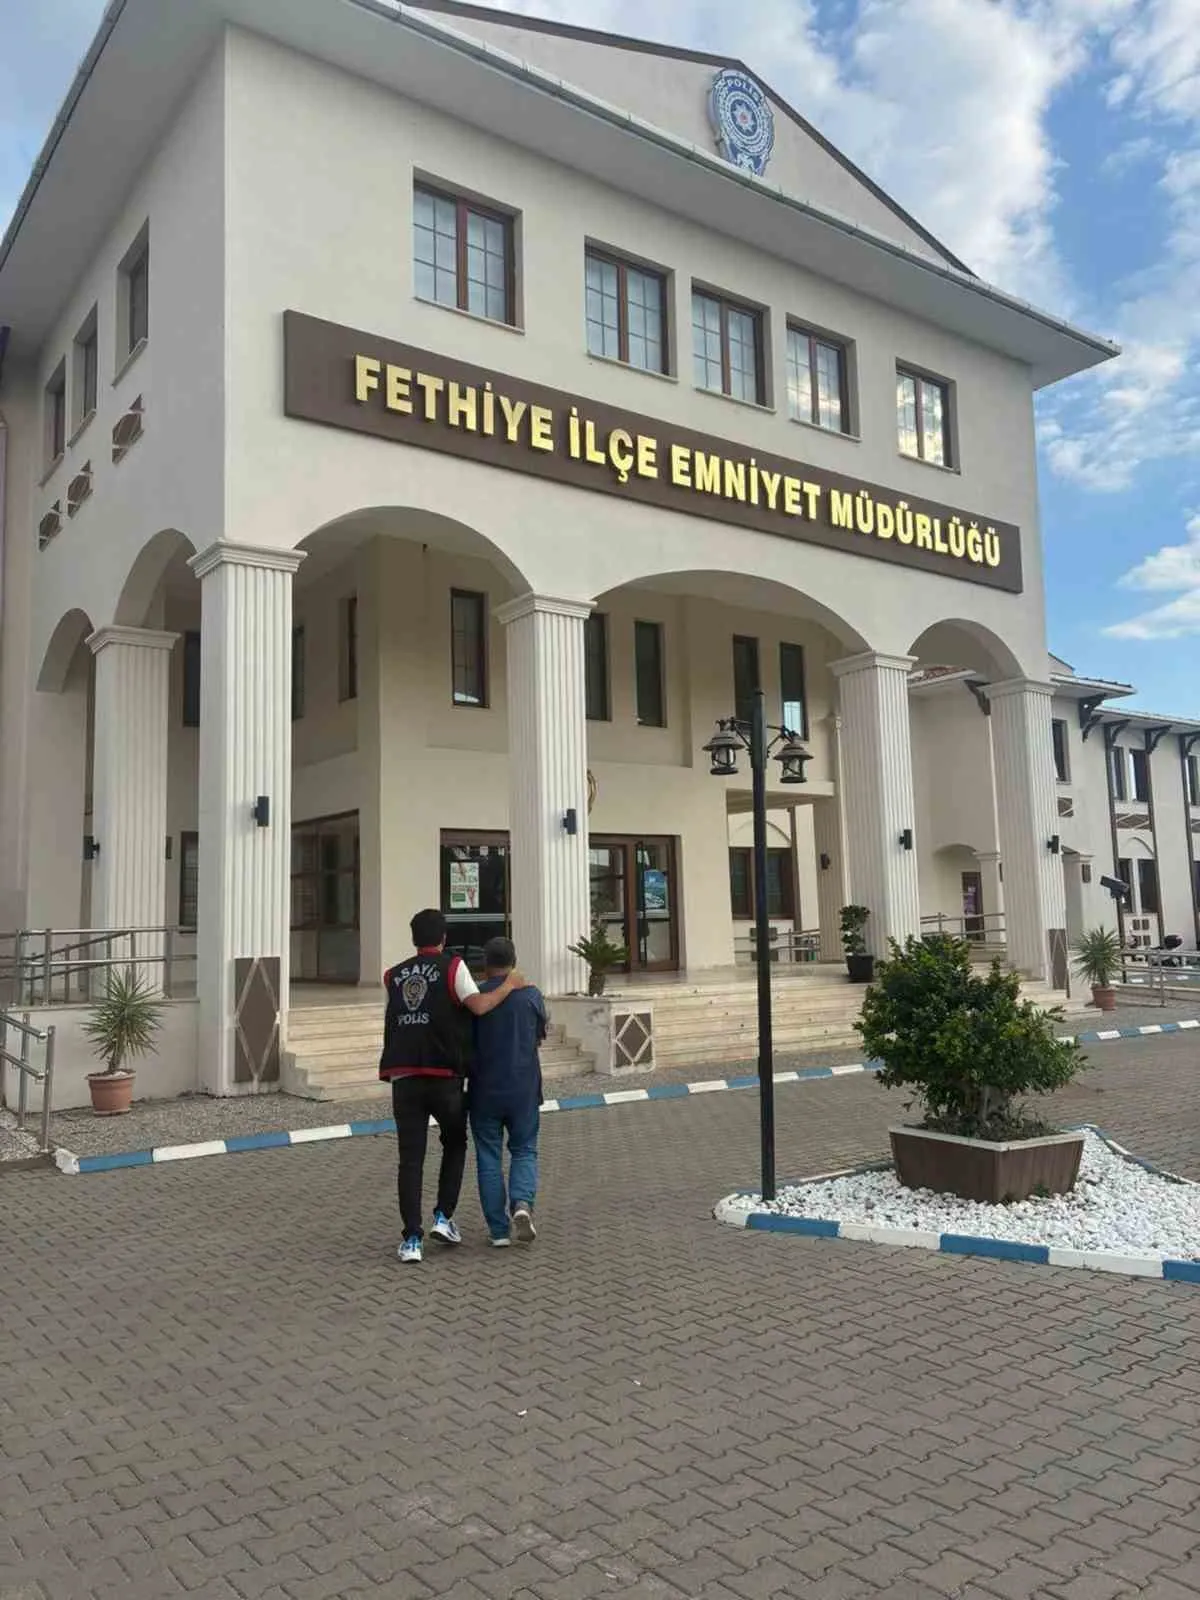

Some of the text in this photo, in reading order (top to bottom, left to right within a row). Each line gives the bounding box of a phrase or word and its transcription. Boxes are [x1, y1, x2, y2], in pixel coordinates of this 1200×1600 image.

[355, 354, 1000, 567] FETHİYE İLÇE EMNİYET MÜDÜRLÜĞÜ
